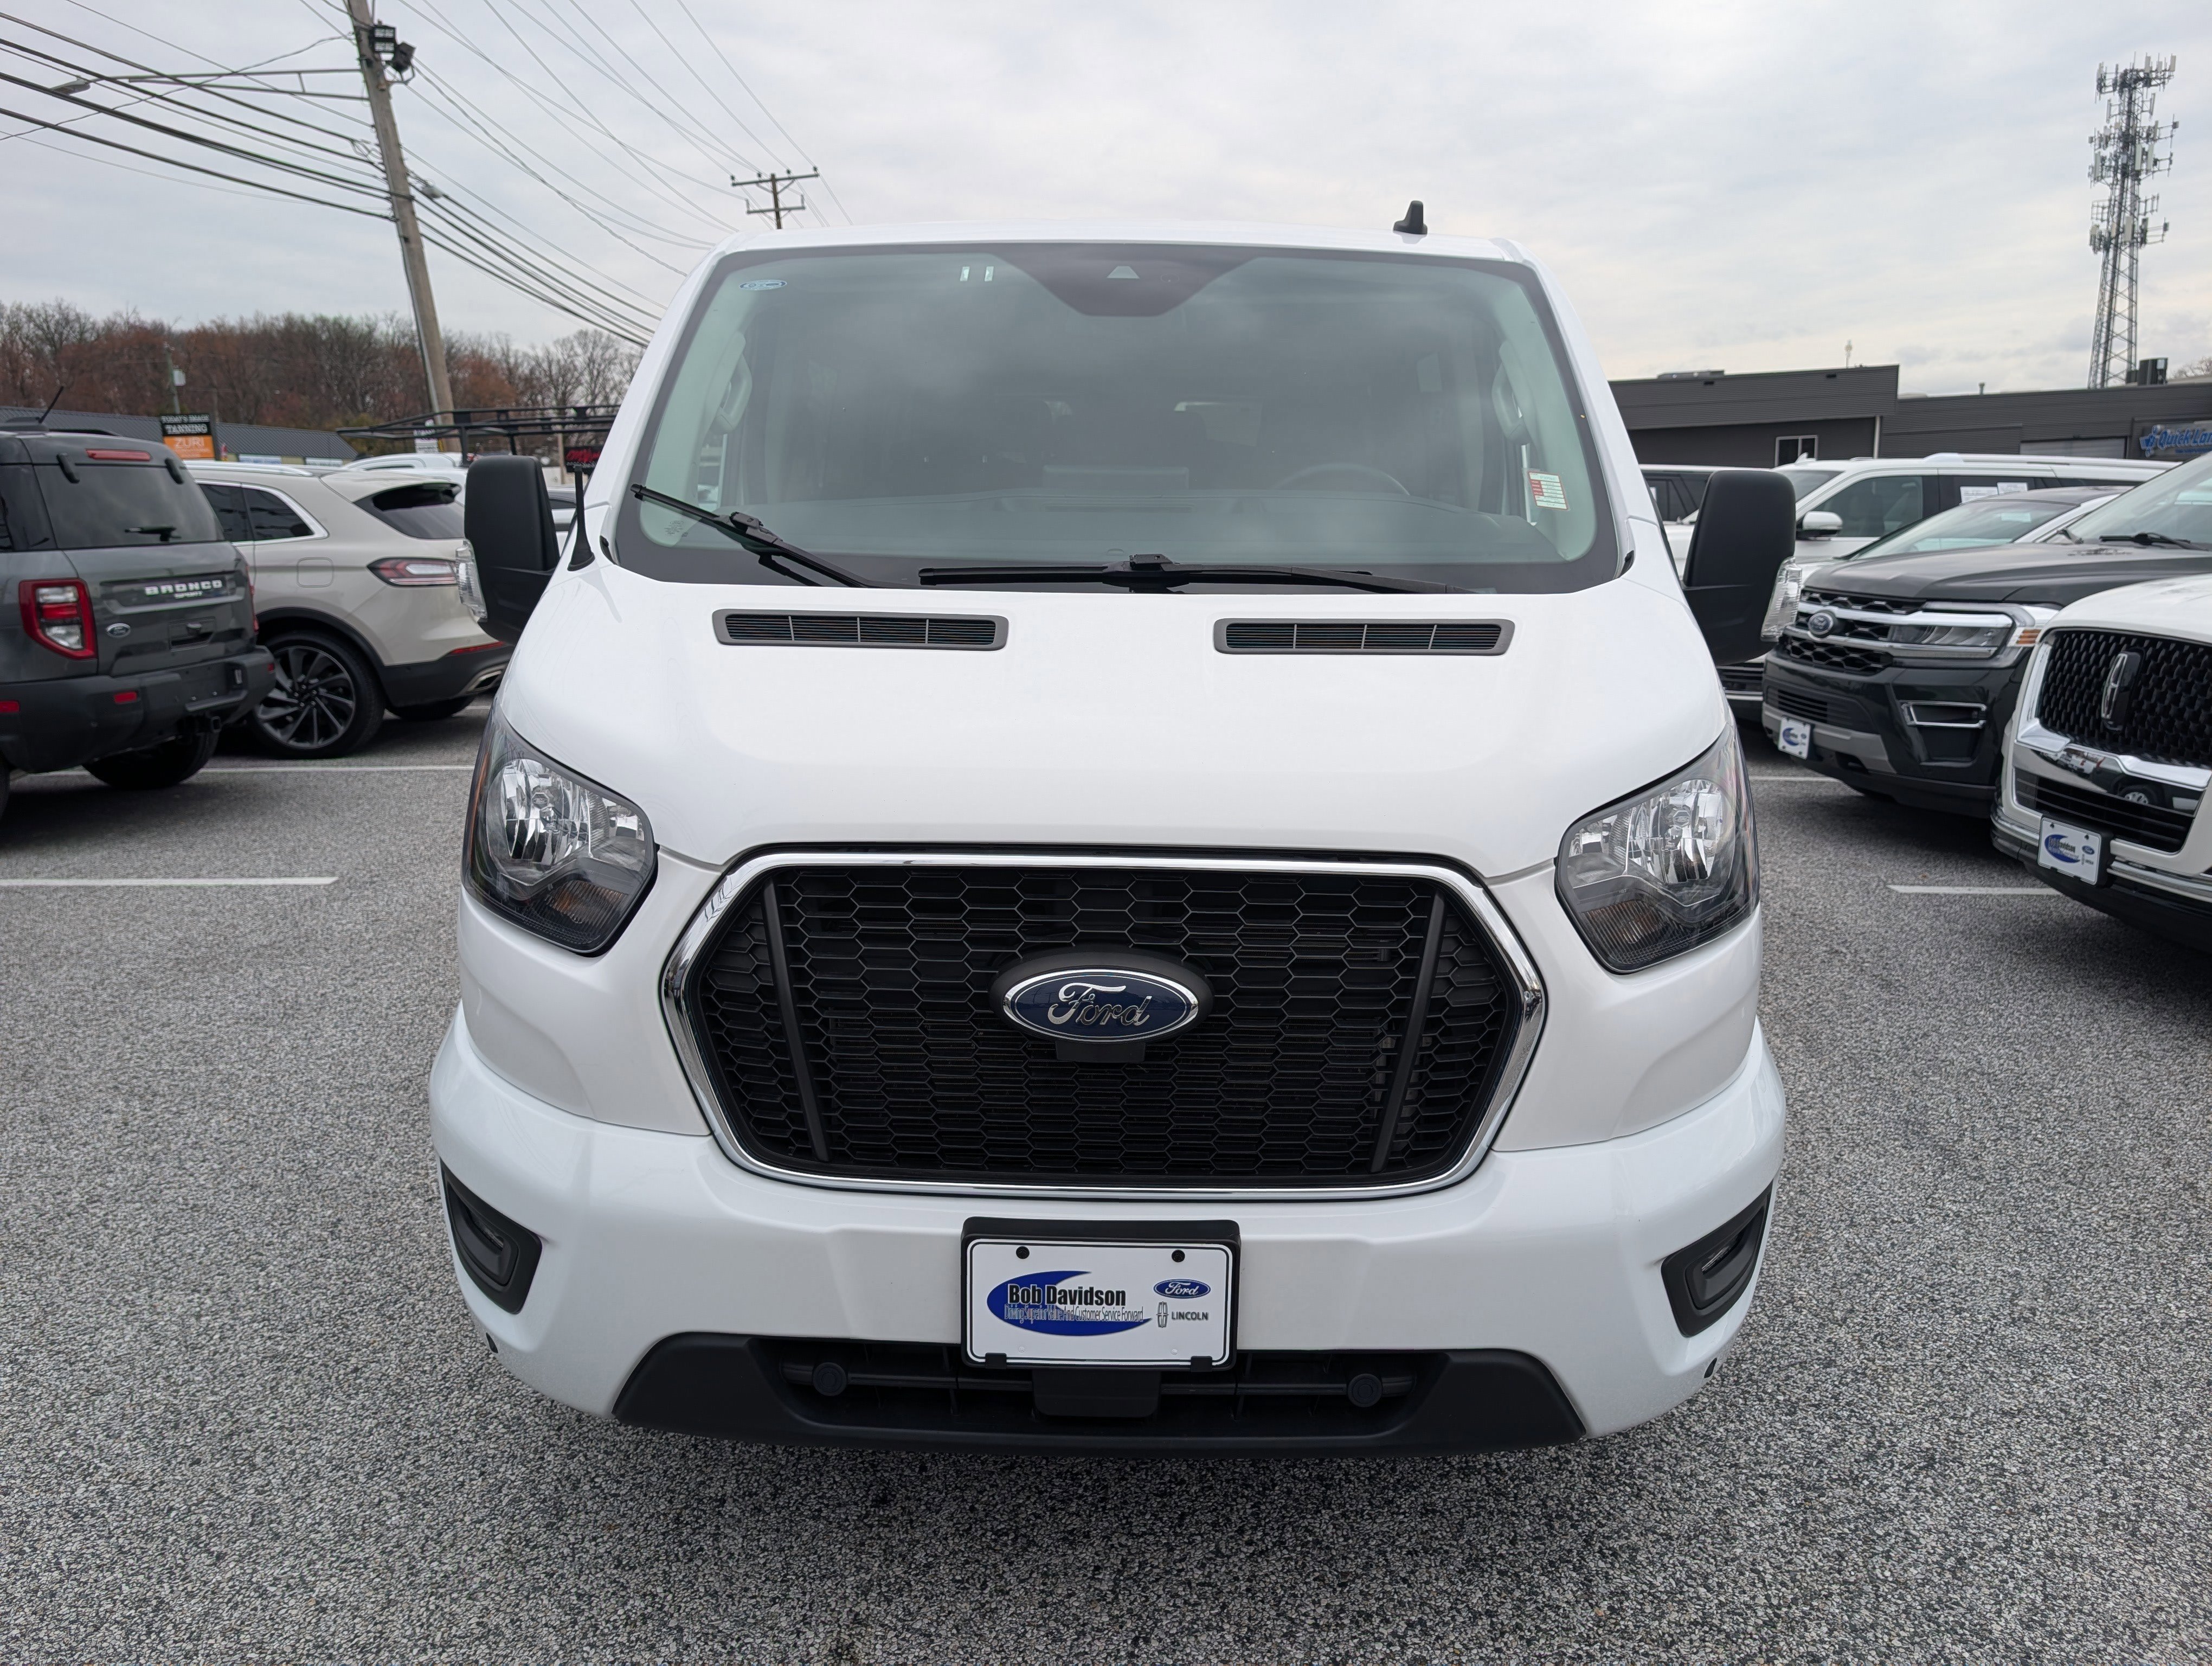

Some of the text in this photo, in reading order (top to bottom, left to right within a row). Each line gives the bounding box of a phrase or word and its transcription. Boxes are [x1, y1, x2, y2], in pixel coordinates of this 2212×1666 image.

[175, 437, 204, 447] ZURI
[2157, 428, 2191, 450] Quick
[144, 580, 222, 595] BRONCO
[1047, 982, 1152, 1026] Ford
[1008, 1284, 1126, 1306] Bob Davidson
[1165, 1281, 1199, 1295] Ford
[1004, 1304, 1143, 1324] Driving Superior Value And Customer Service Forward
[1171, 1311, 1208, 1321] LINCOLN
